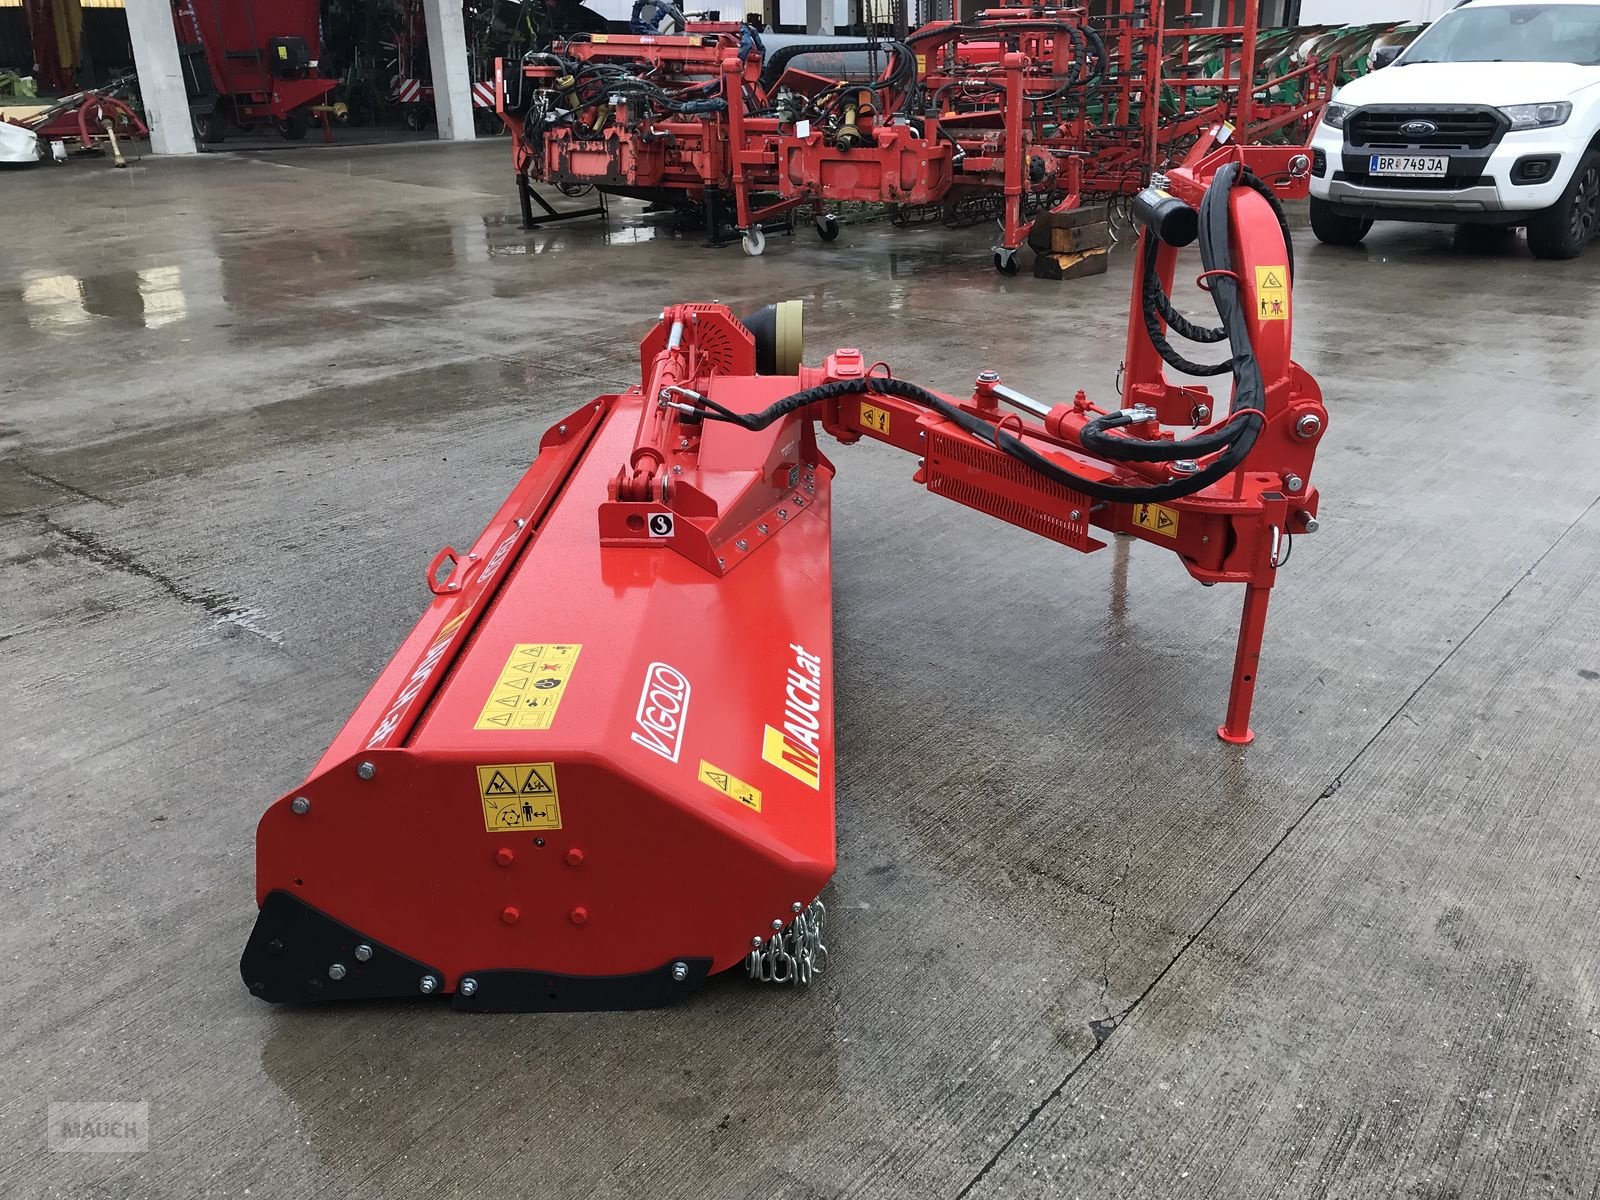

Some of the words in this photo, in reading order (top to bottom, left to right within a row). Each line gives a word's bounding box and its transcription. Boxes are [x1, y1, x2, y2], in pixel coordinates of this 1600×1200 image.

[1380, 158, 1394, 169] BR
[630, 661, 691, 764] VIGOLO
[781, 643, 821, 779] MAUCH.at
